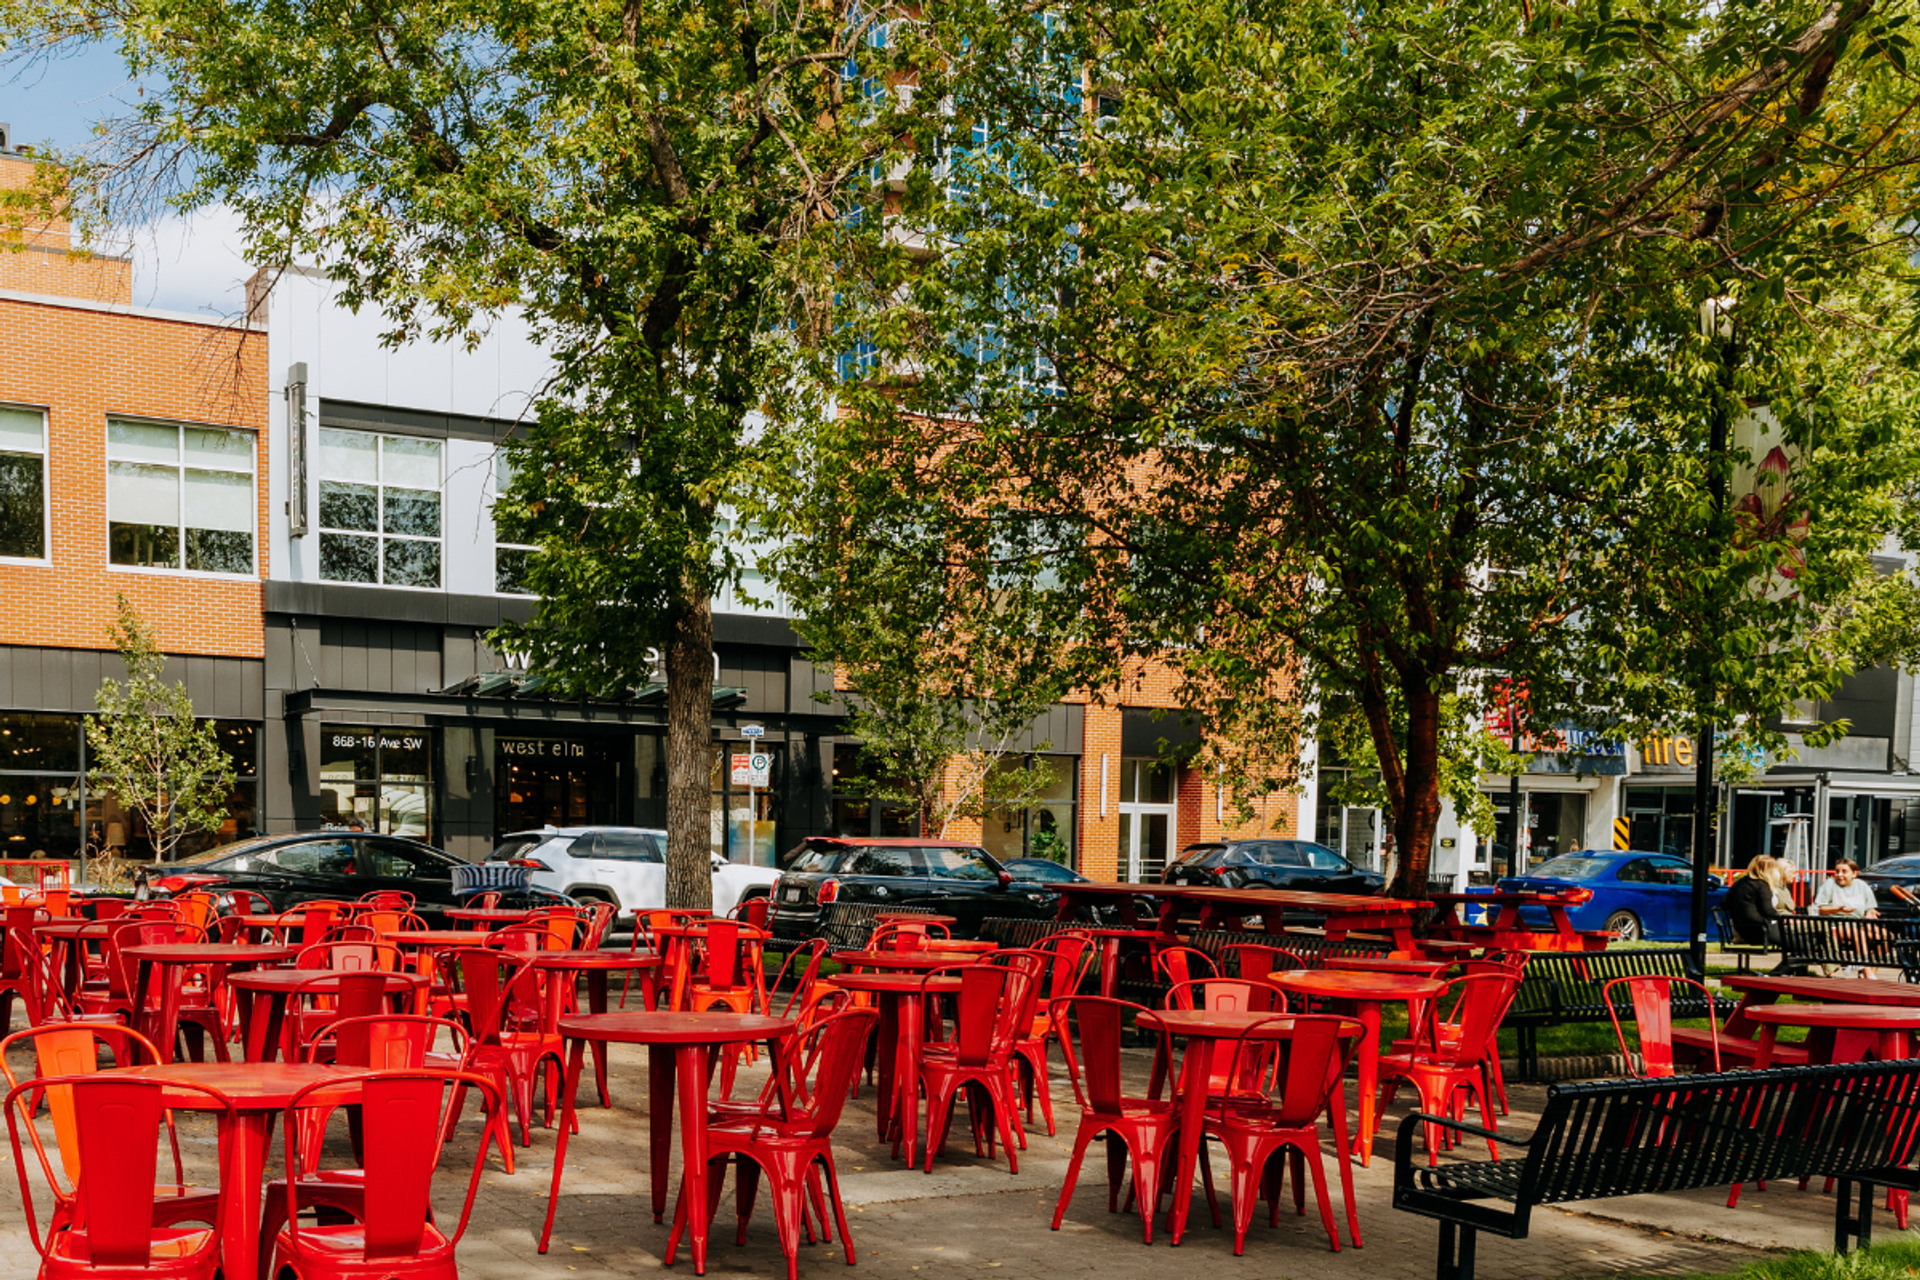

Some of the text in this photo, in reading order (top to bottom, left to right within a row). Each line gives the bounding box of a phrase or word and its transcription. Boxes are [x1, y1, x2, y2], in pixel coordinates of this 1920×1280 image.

[332, 735, 423, 750] 868-16 Ave SW
[502, 740, 584, 757] west elm
